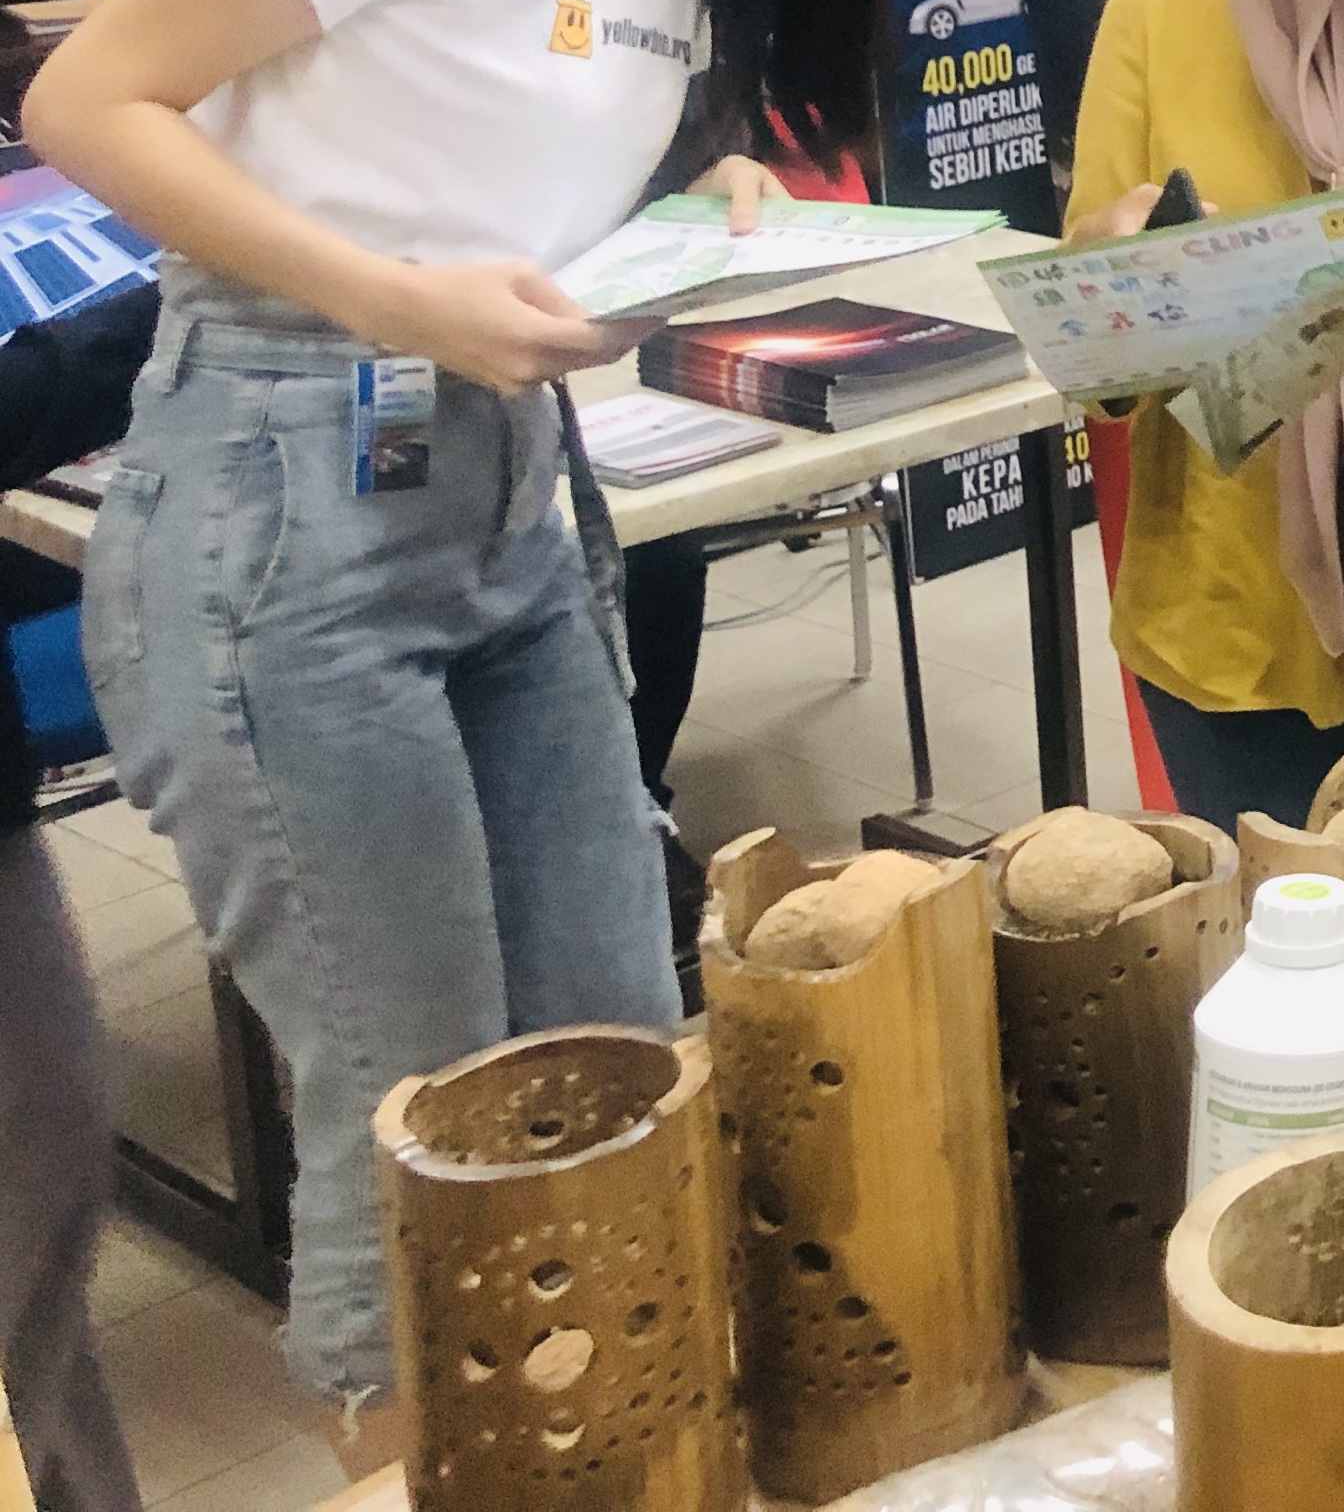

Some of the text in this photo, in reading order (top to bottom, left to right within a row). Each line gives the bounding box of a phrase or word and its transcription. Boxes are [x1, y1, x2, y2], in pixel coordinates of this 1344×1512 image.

[922, 43, 1013, 97] 40,000
[926, 97, 957, 134] AIR
[927, 128, 971, 158] UNTUK
[929, 147, 991, 190] SEBIJI
[962, 453, 1023, 500] KEPA
[946, 500, 989, 531] PADA
